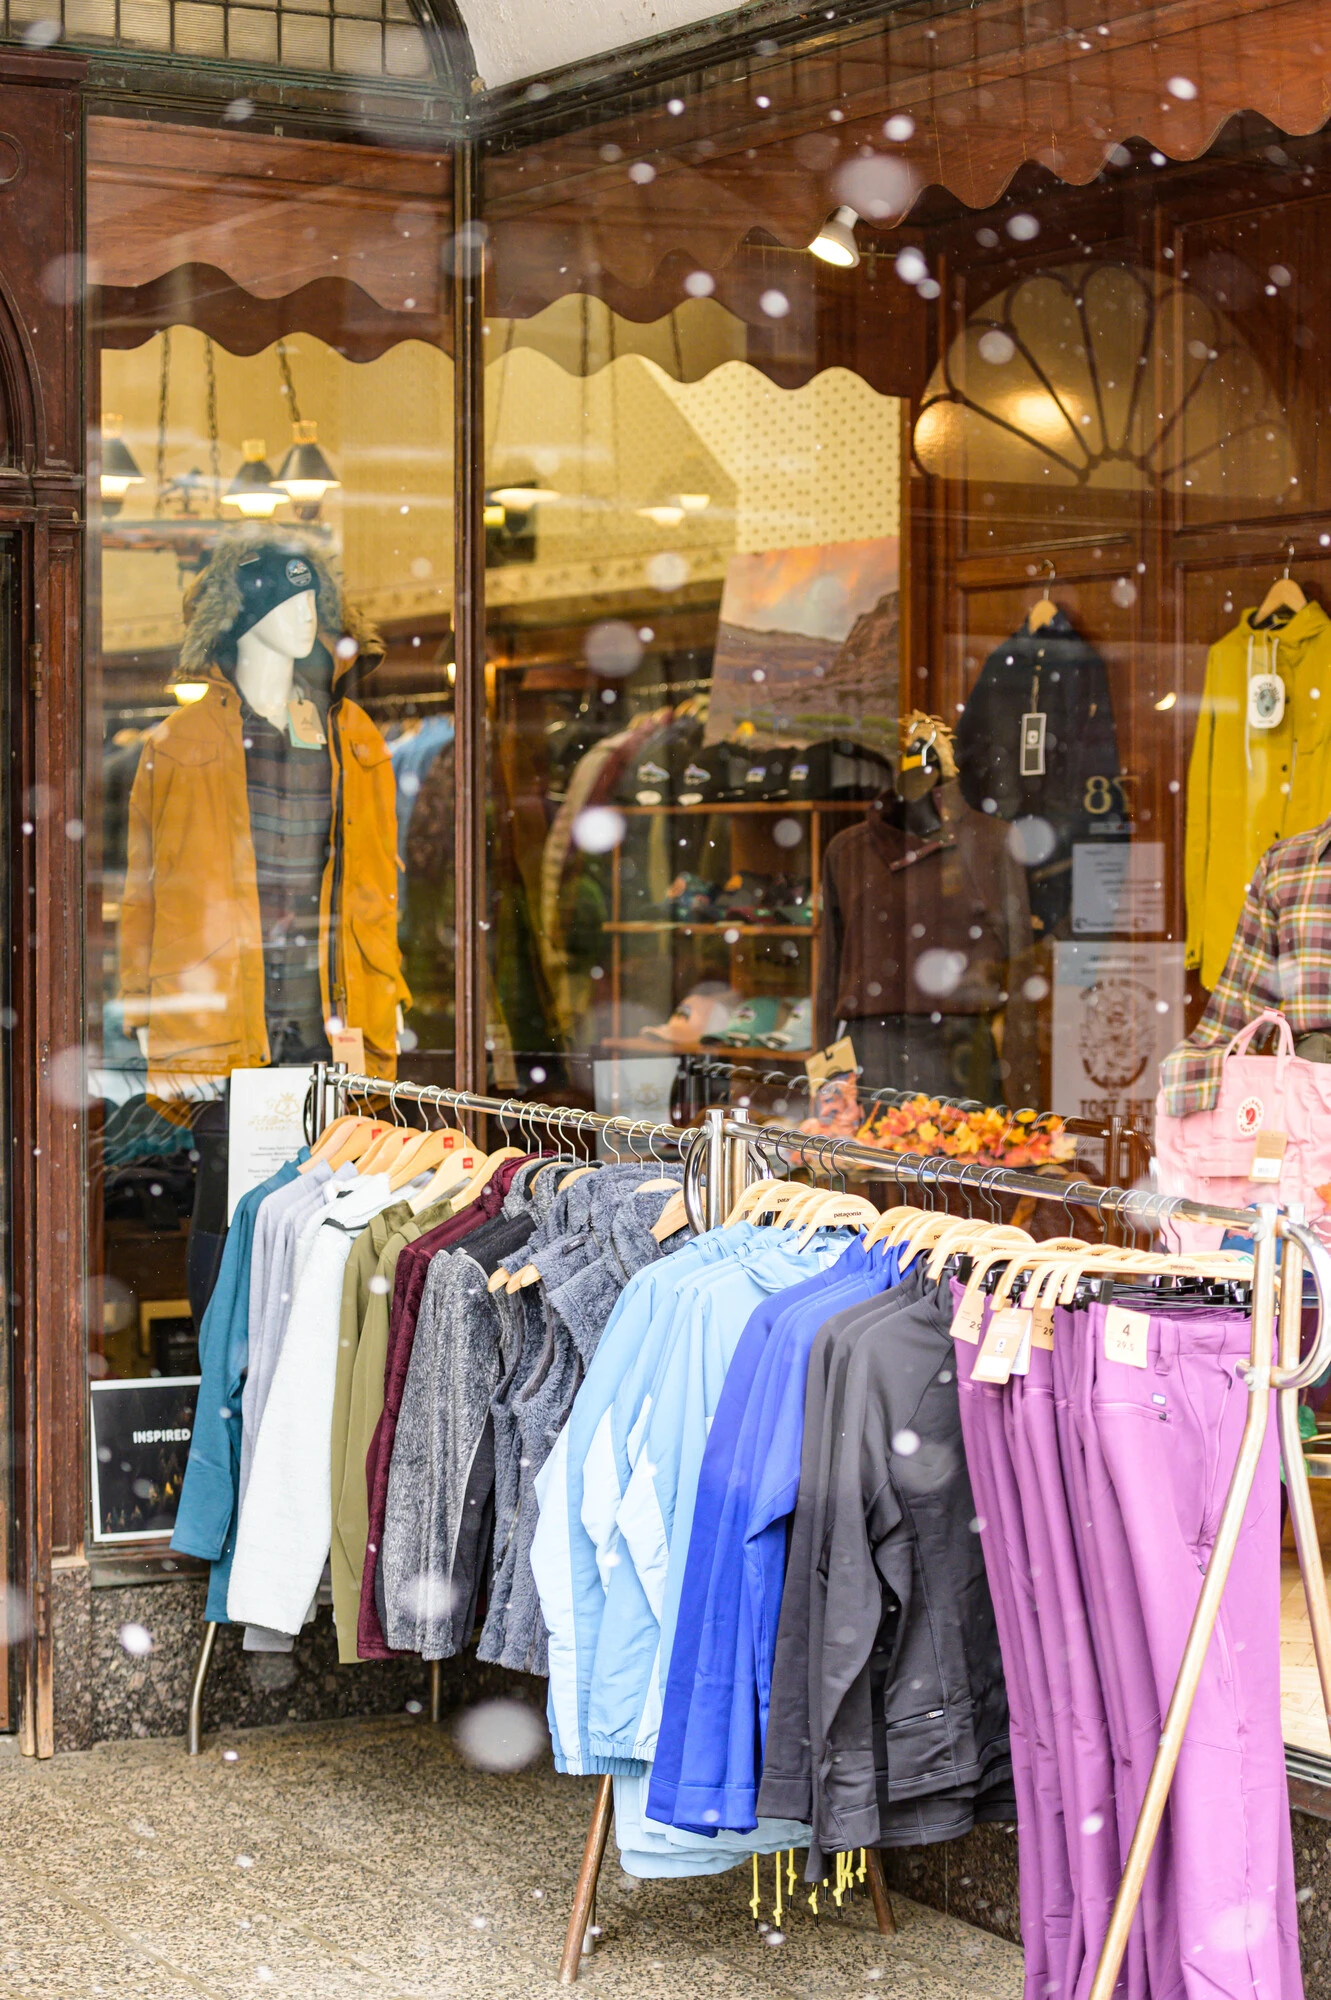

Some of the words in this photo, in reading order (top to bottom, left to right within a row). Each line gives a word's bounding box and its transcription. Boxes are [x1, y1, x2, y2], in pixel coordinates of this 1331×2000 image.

[833, 1211, 862, 1219] patagonia
[1122, 1323, 1131, 1337] 4
[132, 1427, 192, 1444] INSPIRED
